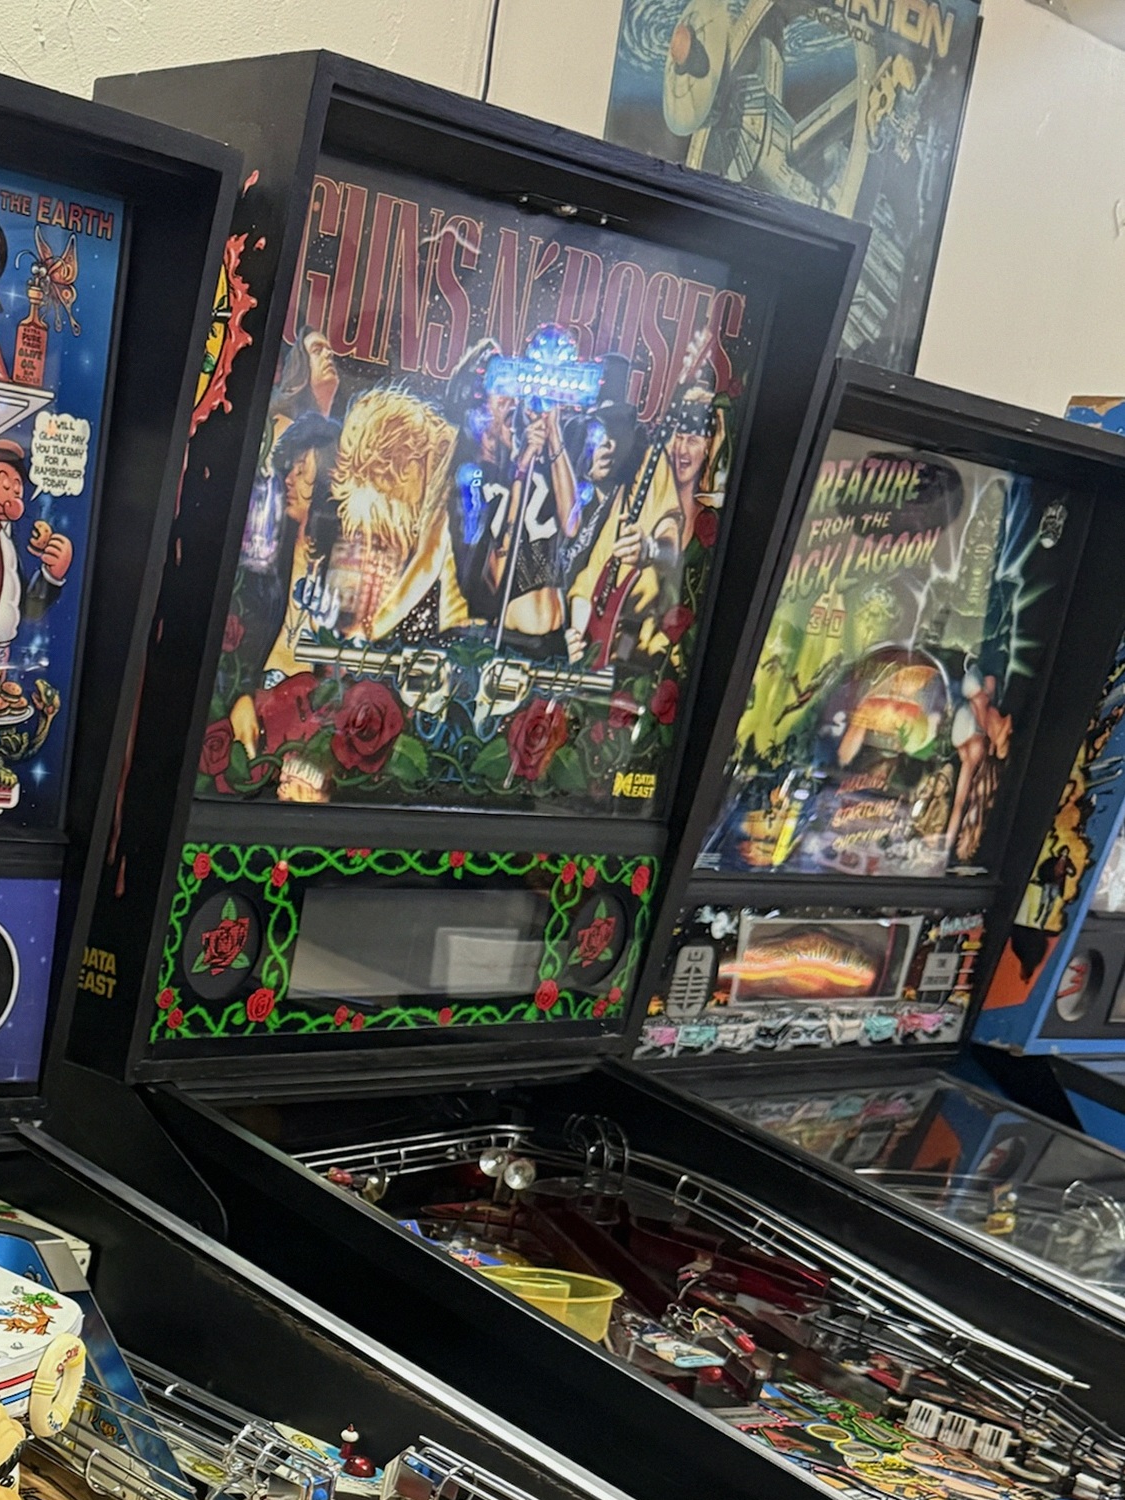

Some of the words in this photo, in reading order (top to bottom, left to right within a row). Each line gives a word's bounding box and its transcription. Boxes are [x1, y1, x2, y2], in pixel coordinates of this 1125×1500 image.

[0, 189, 32, 217] THE
[36, 198, 115, 241] EARTH
[281, 174, 483, 381] GUNS
[553, 245, 746, 423] ROSES
[810, 456, 927, 513] REATURE
[807, 515, 856, 548] FROM
[861, 511, 893, 534] THE
[782, 542, 842, 601] ACK
[836, 526, 942, 593] LAGOON
[632, 786, 655, 798] EAST
